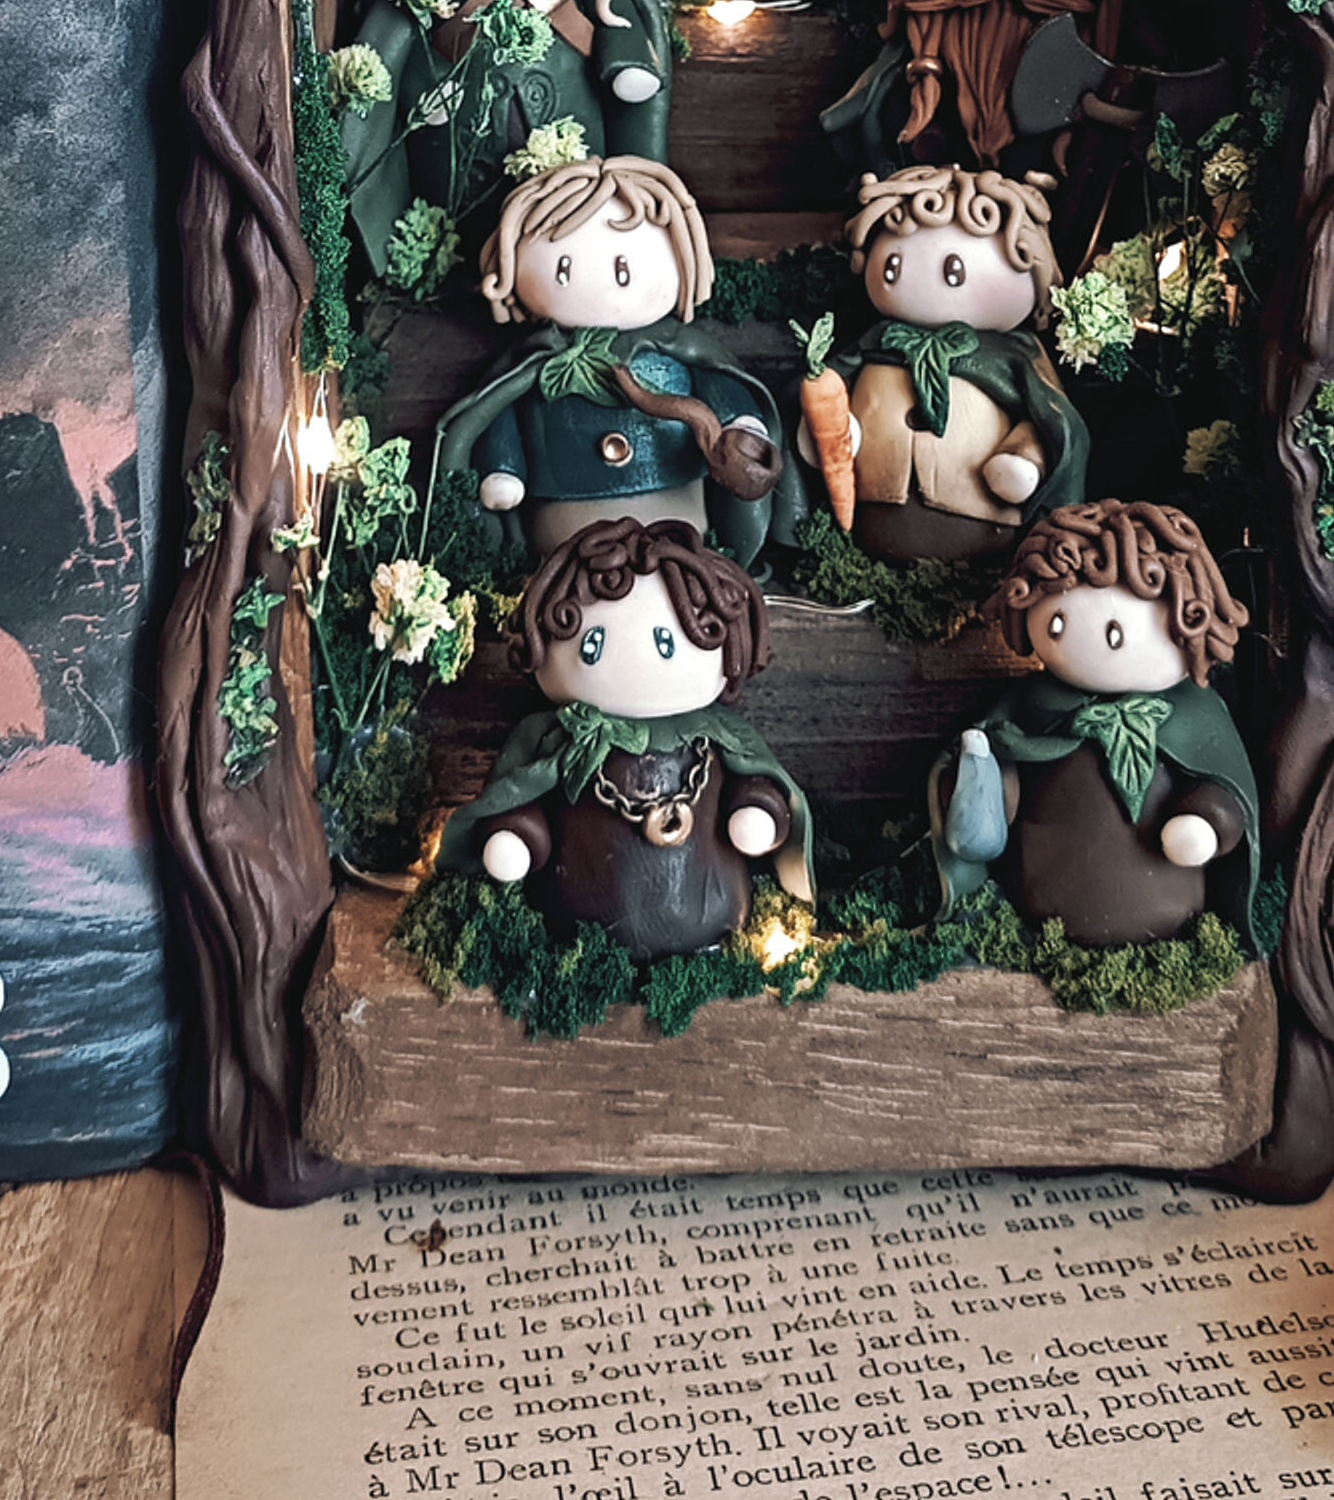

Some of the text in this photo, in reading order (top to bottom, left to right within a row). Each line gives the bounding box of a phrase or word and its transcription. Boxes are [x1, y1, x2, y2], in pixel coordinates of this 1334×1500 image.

[357, 1258, 1334, 1379] soudain, un vif rayon pénétra à travers les vitres de la
[395, 1327, 439, 1349] Ce
[457, 1322, 506, 1343] fut
[521, 1317, 547, 1336] le
[561, 1303, 646, 1332] soleil
[659, 1302, 714, 1326] qui
[725, 1293, 767, 1314] lui
[781, 1286, 847, 1308] vint
[859, 1283, 896, 1299] en
[909, 1270, 987, 1294] aide.
[996, 1265, 1043, 1285] Le
[1055, 1250, 1154, 1277] temps
[361, 1323, 970, 1407] fenêtre qui s'ouvrait sur le jardin.
[364, 1435, 449, 1466] était
[464, 1430, 520, 1454] sur
[538, 1423, 597, 1445] son
[616, 1405, 753, 1434] donjon,
[767, 1392, 841, 1419] telle
[854, 1386, 904, 1409] est
[917, 1380, 953, 1401] la
[967, 1366, 1080, 1403] pensée
[1095, 1357, 1150, 1387] qui
[1165, 1351, 1234, 1375] vint
[405, 1407, 437, 1431] A
[458, 1403, 494, 1422] ce
[515, 1384, 666, 1417] moment,
[686, 1376, 764, 1399] sans
[779, 1363, 838, 1388] nul
[859, 1353, 966, 1380] doute,
[980, 1345, 1014, 1366] le
[1045, 1332, 1169, 1360] docteur
[368, 1474, 389, 1499] à
[405, 1465, 459, 1493] Mr
[475, 1457, 571, 1486] Dean
[587, 1432, 742, 1474] Forsyth.
[753, 1426, 785, 1451] Il
[797, 1412, 911, 1448] voyait
[924, 1409, 984, 1431] son
[996, 1393, 1090, 1423] rival,
[1099, 1376, 1250, 1418] profitant
[1263, 1369, 1306, 1394] de
[664, 1472, 685, 1497] à
[709, 1450, 877, 1492] l'oculaire
[898, 1441, 942, 1467] de
[966, 1437, 1027, 1460] son
[1046, 1416, 1204, 1450] télescope
[1226, 1405, 1262, 1429] et
[1278, 1467, 1333, 1490] sur
